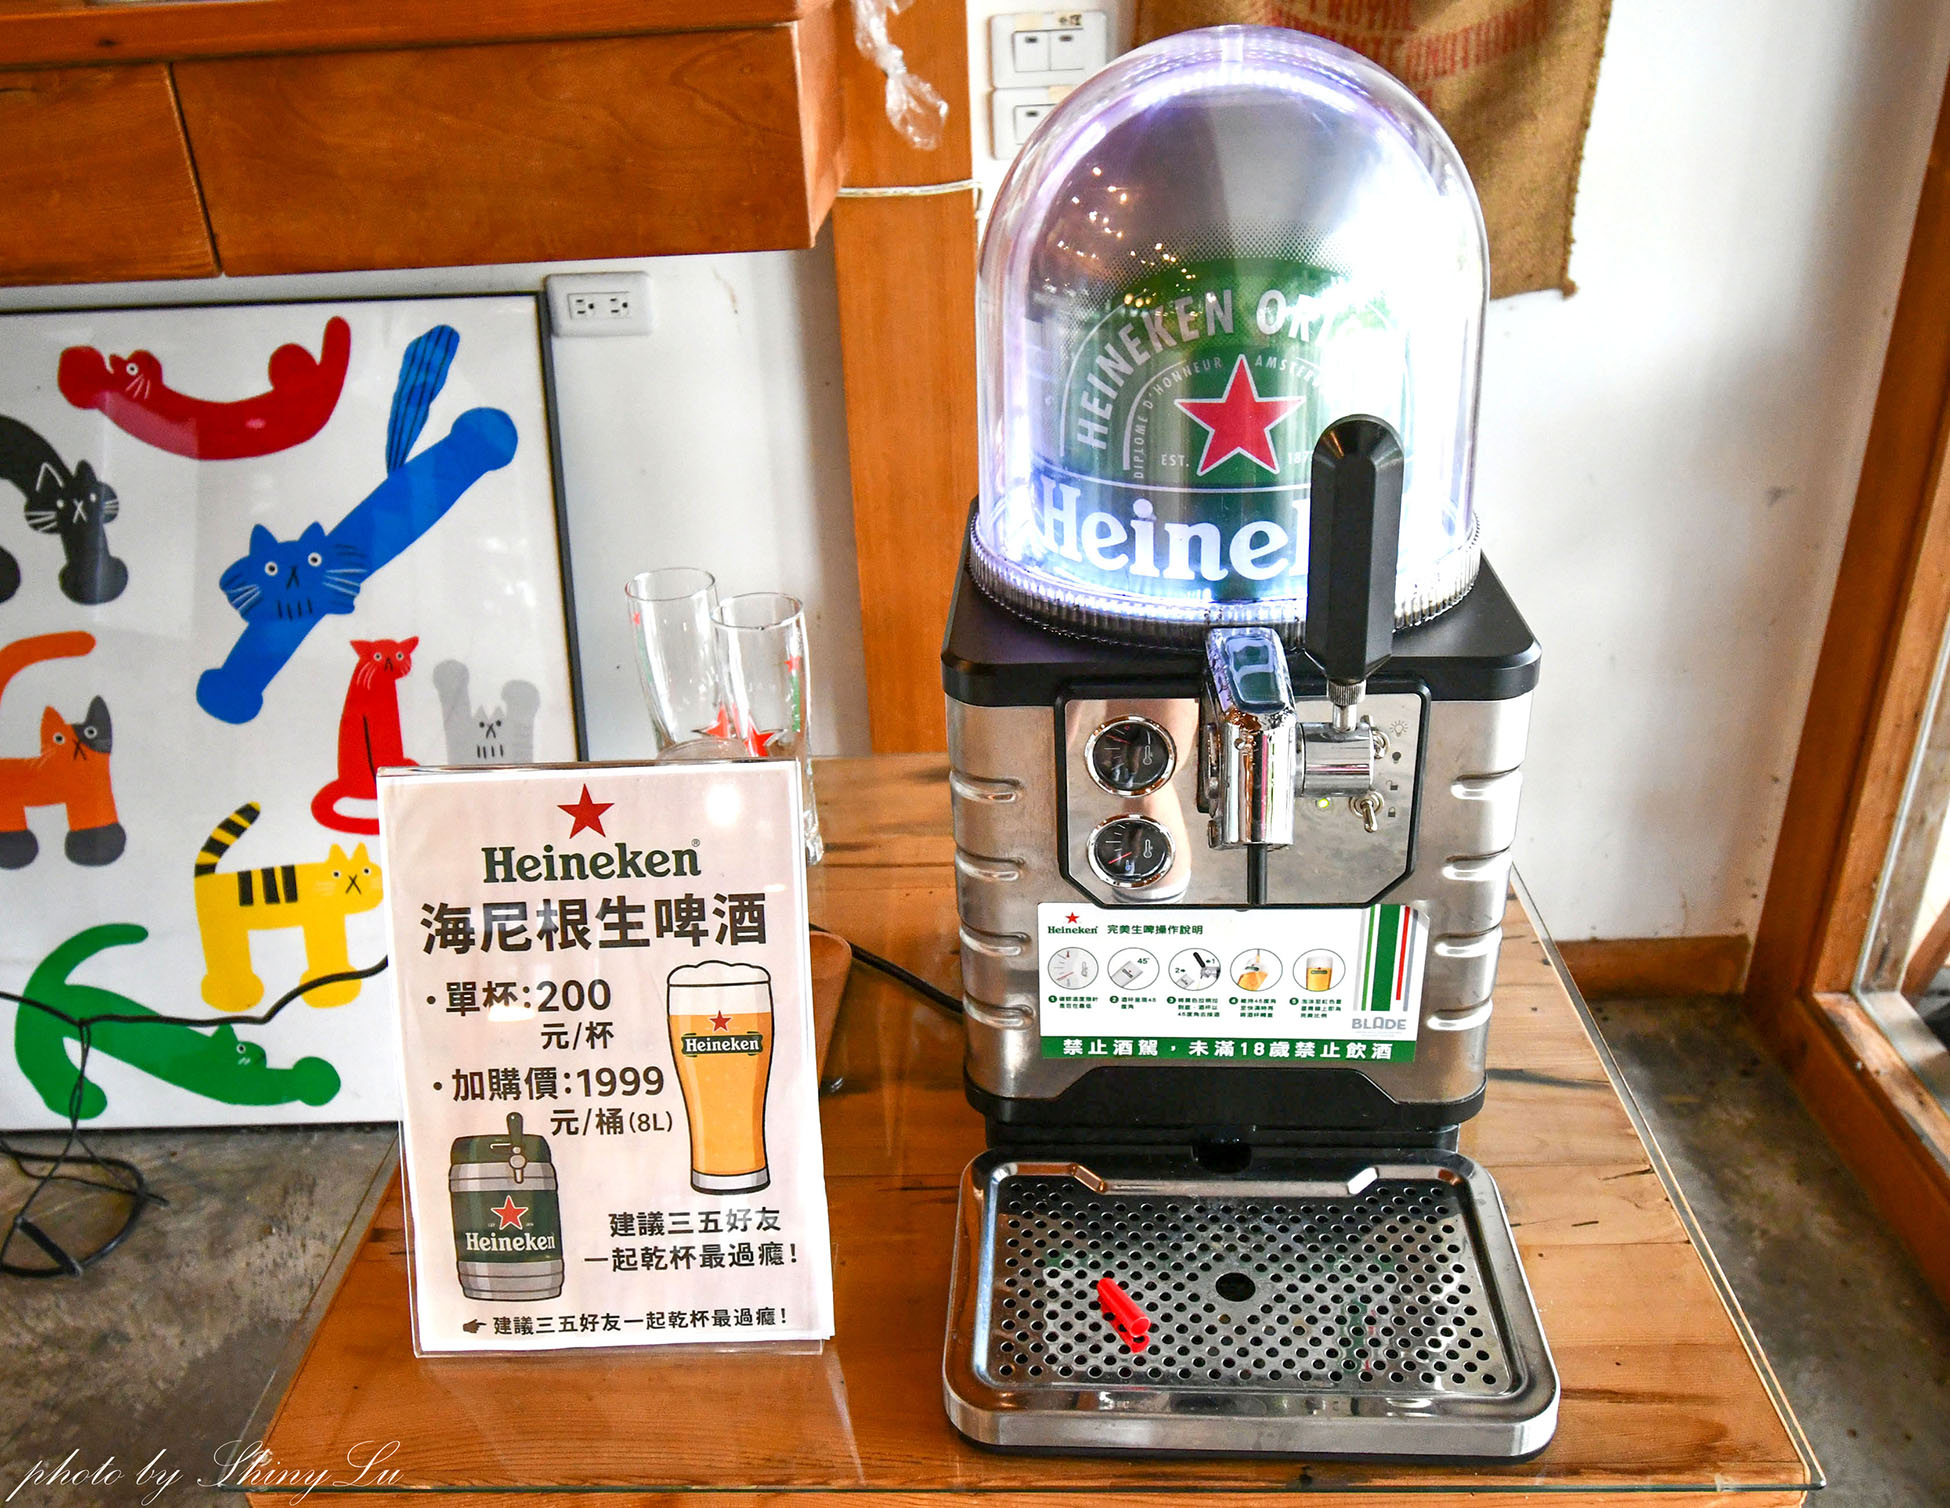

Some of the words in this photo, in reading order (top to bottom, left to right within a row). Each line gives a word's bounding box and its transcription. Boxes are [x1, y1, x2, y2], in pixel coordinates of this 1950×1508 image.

[1076, 289, 1234, 450] HEINEKEN
[1161, 454, 1190, 468] EST.
[482, 843, 701, 883] Heineken
[420, 892, 767, 955] 海尼根生啤酒
[1048, 925, 1098, 934] Heineken
[1351, 1016, 1407, 1030] BLADE
[541, 1021, 615, 1051] 元/杯
[684, 1037, 760, 1052] Heineken
[608, 1207, 782, 1238] 建議三五好友
[466, 1231, 556, 1252] Heineken
